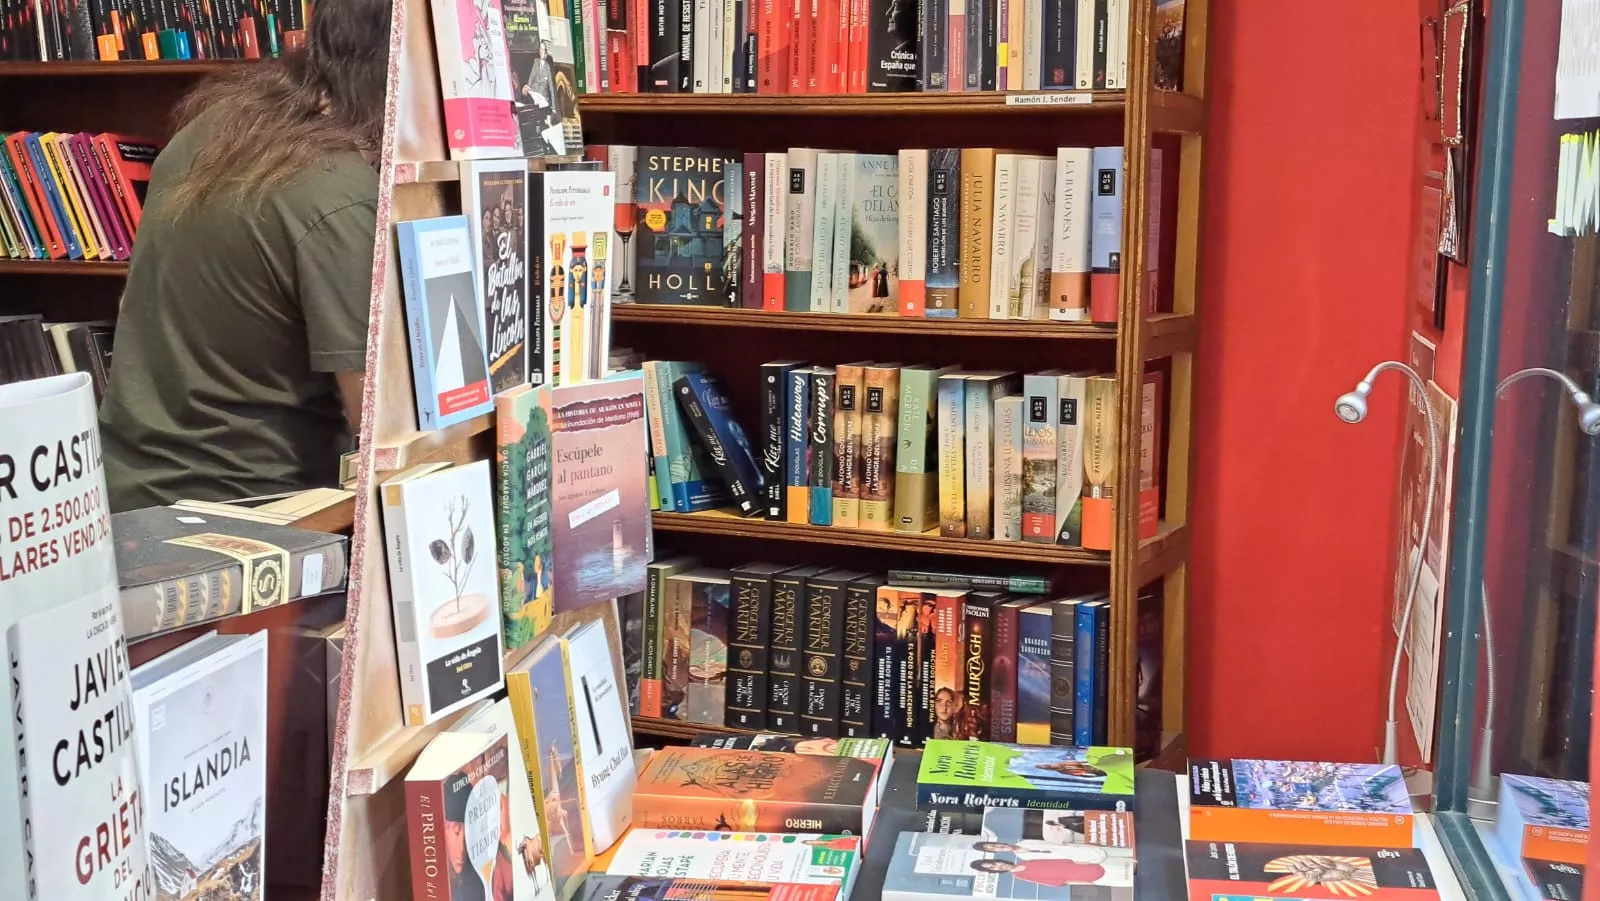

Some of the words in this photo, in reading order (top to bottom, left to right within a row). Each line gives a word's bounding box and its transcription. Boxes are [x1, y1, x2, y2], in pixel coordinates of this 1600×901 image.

[683, 23, 691, 32] DE
[682, 33, 691, 61] MANUAL
[891, 50, 914, 59] Crónica
[880, 60, 903, 70] España
[904, 63, 916, 71] que
[1015, 96, 1040, 104] Ramón
[1050, 96, 1076, 104] Sender
[862, 160, 888, 170] ANNE
[1065, 160, 1075, 175] LA
[972, 173, 983, 212] JULIA
[999, 169, 1008, 198] JULIA
[749, 201, 757, 226] Megan
[1062, 179, 1074, 240] BARONESA
[997, 204, 1007, 256] NAVARRO
[971, 218, 982, 283] NAVARRO
[649, 274, 724, 291] HOLL
[565, 409, 589, 418] HISTORIA
[789, 375, 805, 442] Hideaway
[813, 377, 831, 444] Corrupt
[904, 385, 912, 433] MORTON
[910, 398, 920, 421] KATE
[567, 417, 596, 428] inundación
[526, 443, 547, 462] GABRIEL
[557, 443, 603, 464] Escúpele
[764, 444, 780, 473] Kiss
[526, 460, 547, 481] GARCÍA
[557, 469, 566, 484] al
[570, 464, 613, 486] pantano
[865, 459, 873, 487] ALFONSO
[503, 479, 511, 514] MÁRQUEZ
[527, 479, 547, 500] MÁRQUEZ
[9, 512, 36, 542] DE
[503, 524, 509, 534] EN
[737, 586, 750, 641] MARTIN
[773, 589, 785, 644] MARTIN
[809, 593, 821, 649] MARTIN
[844, 597, 856, 652] MARTIN
[967, 634, 984, 706] MURTAGH
[11, 651, 28, 798] JAVIER
[164, 736, 251, 813] ISLANDIA
[929, 754, 953, 777] Nora
[954, 744, 980, 780] Roberts
[110, 776, 123, 802] LA
[420, 795, 430, 808] El
[928, 792, 958, 805] Nora
[963, 793, 1019, 807] Roberts
[1026, 799, 1070, 809] Identidad
[468, 792, 497, 824] PRECIO
[660, 816, 704, 825] YARROS
[785, 818, 822, 830] HIERRO
[422, 812, 438, 878] PRECIO
[426, 881, 437, 898] del
